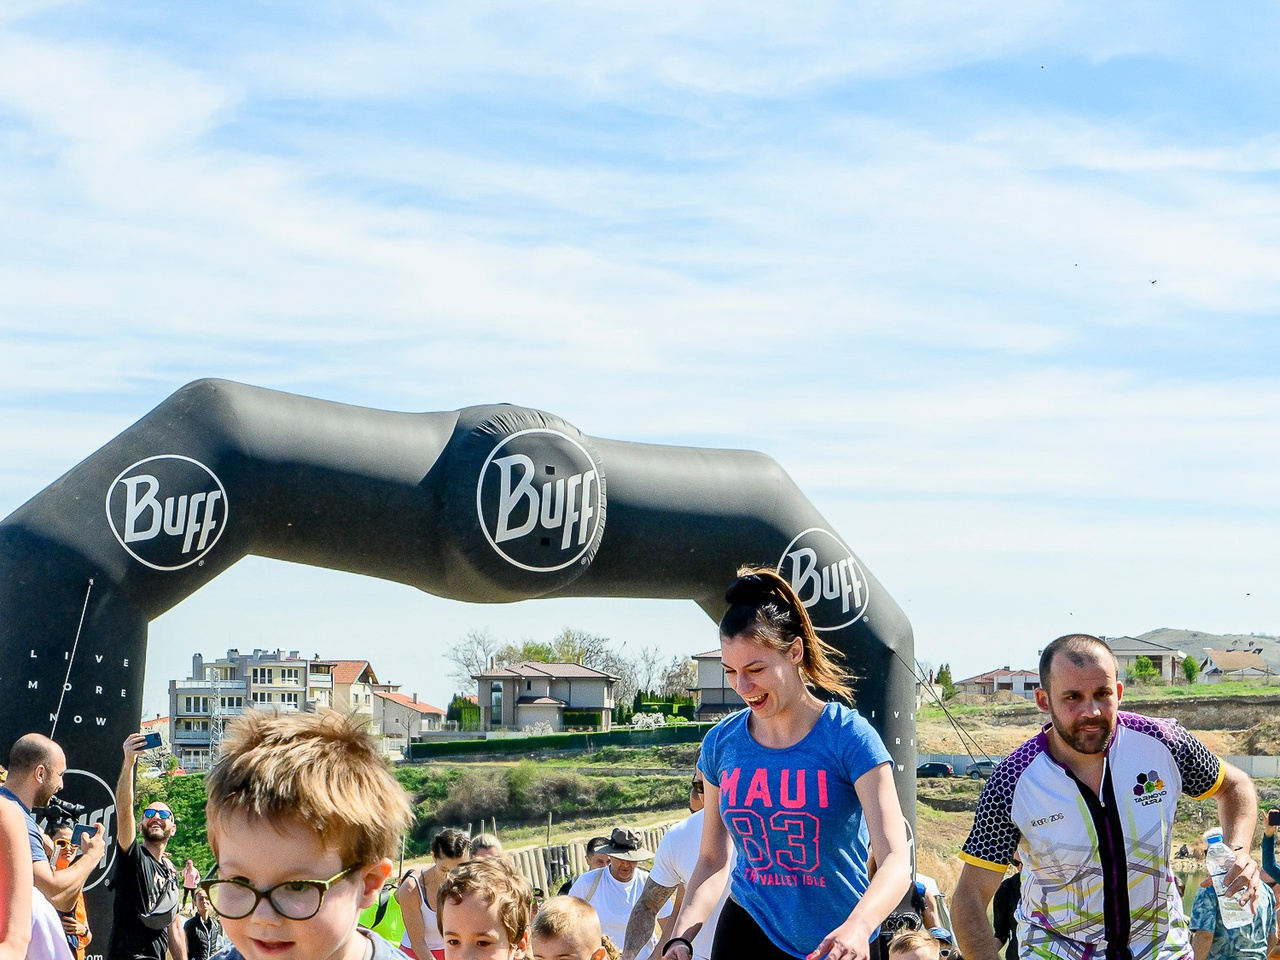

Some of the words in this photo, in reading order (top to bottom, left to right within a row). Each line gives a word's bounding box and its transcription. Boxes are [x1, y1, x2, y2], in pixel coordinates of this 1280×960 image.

[30, 650, 129, 668] LIVE
[28, 681, 126, 698] MORE
[50, 712, 106, 725] NOW
[719, 767, 829, 809] MAUI
[723, 809, 819, 872] 83
[759, 873, 797, 887] VALLEY
[802, 873, 826, 888] ISLE
